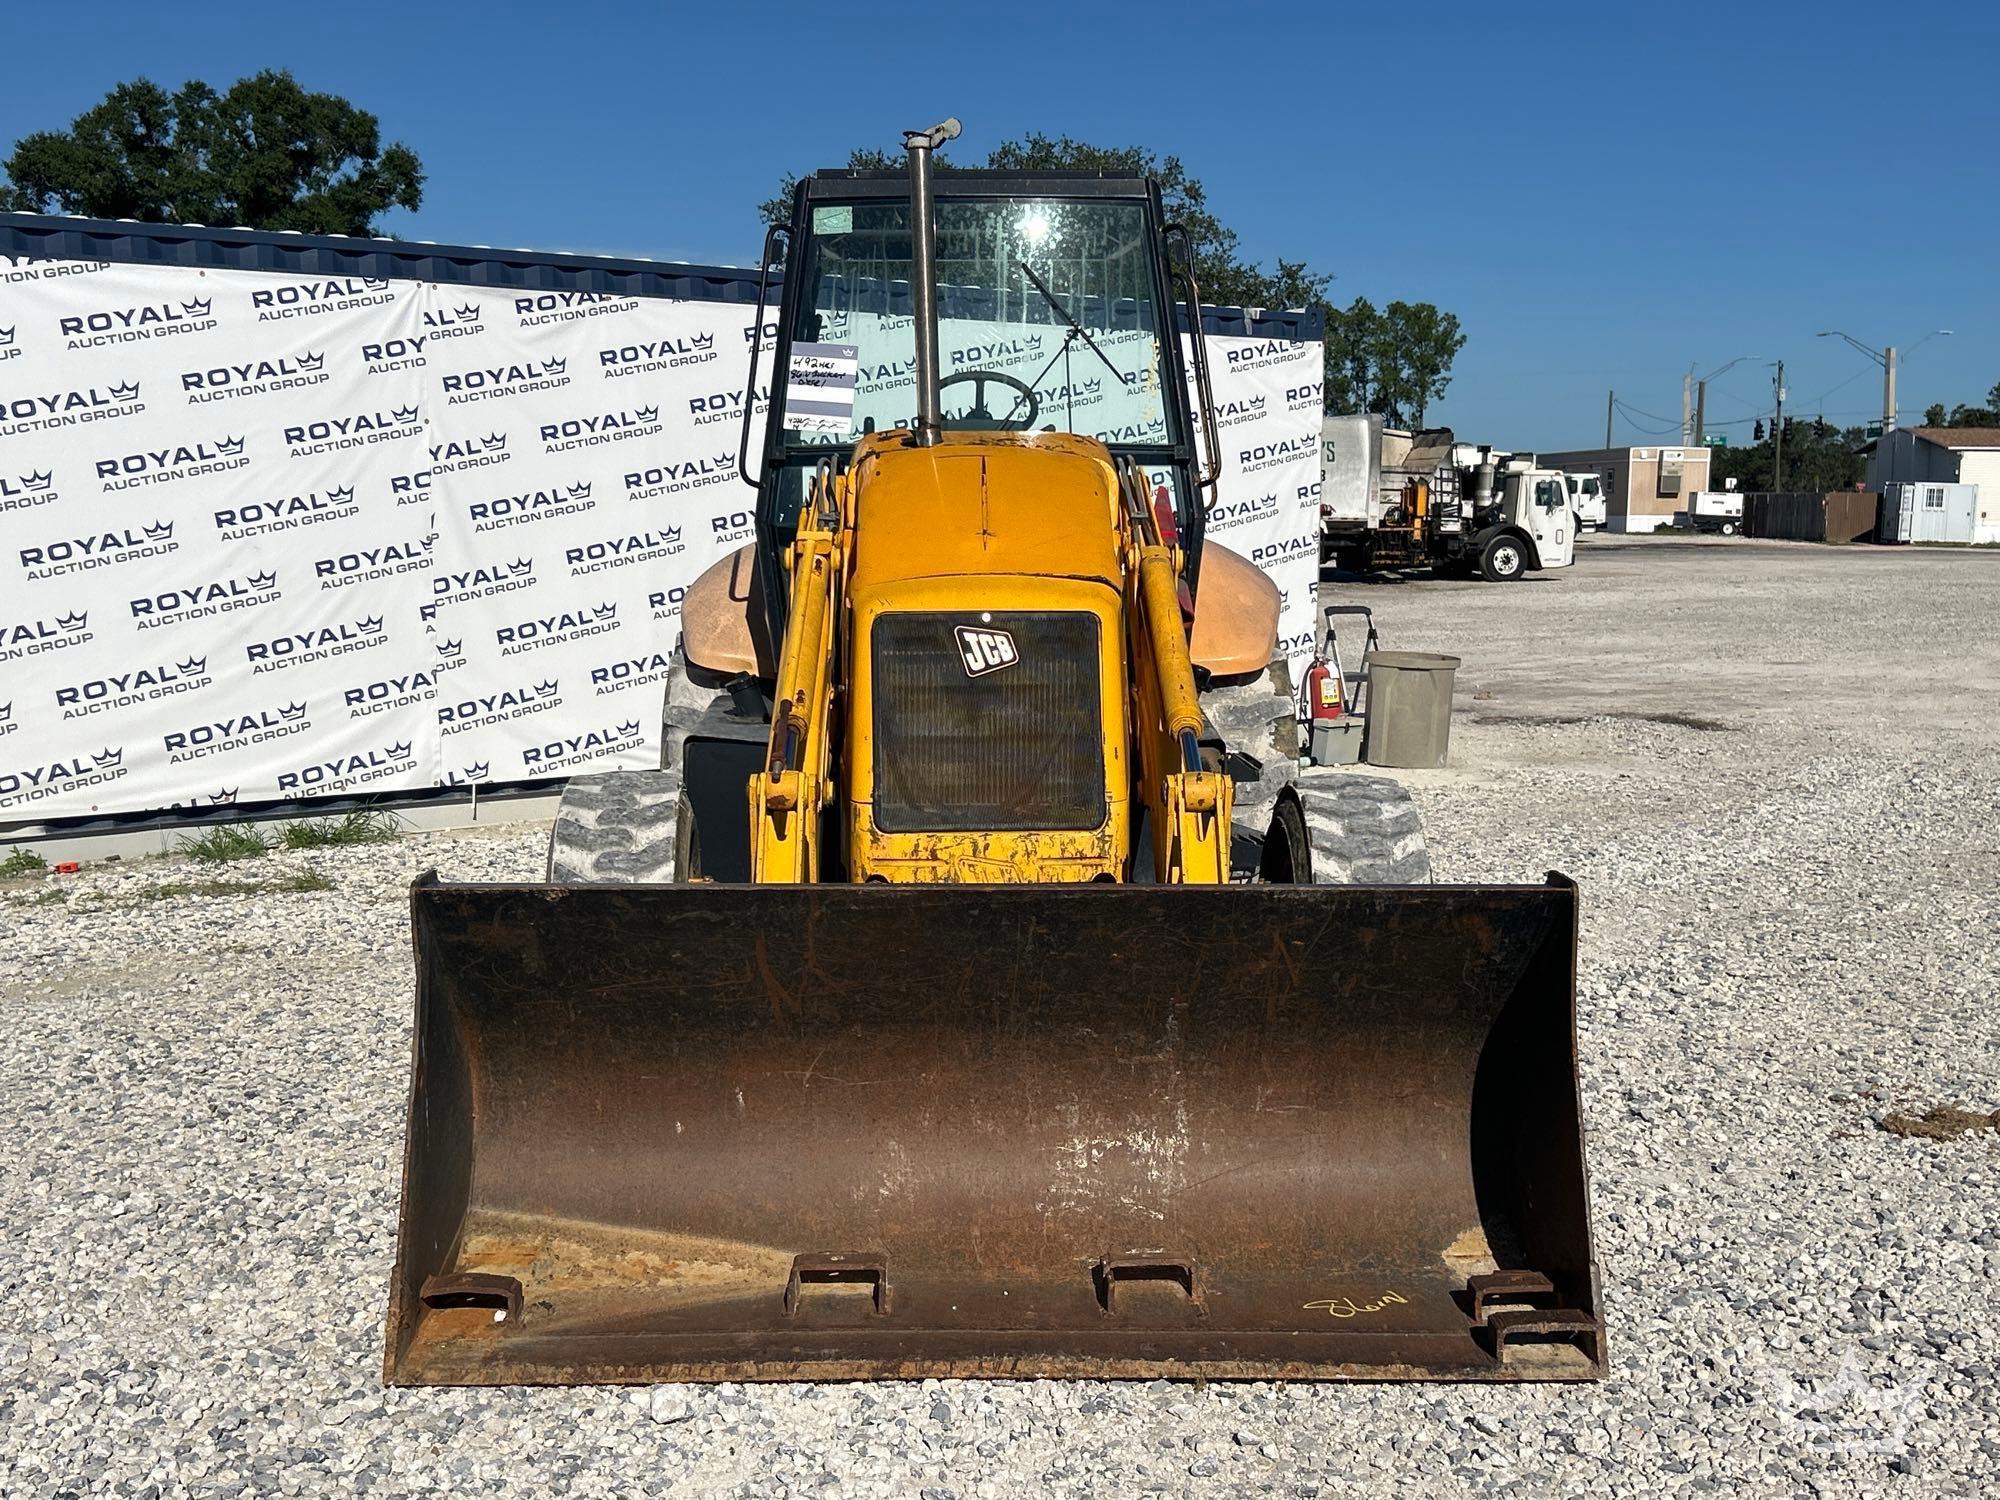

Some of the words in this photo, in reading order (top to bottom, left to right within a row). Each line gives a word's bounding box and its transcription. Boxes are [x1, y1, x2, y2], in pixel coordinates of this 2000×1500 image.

[43, 262, 110, 278] GROUP
[252, 279, 363, 309] ROYAL
[258, 303, 334, 322] AUCTION
[337, 293, 395, 311] GROUP
[60, 304, 183, 336] ROYAL
[519, 309, 585, 328] AUCTION
[588, 301, 639, 318] GROUP
[880, 320, 915, 331] AUCTI
[67, 329, 150, 350] AUCTION
[154, 320, 218, 338] GROUP
[430, 324, 484, 341] GROUP
[1117, 331, 1154, 346] GROUP
[362, 337, 426, 362] ROY
[599, 338, 692, 366] ROYAL
[951, 340, 1023, 365] ROYAL
[1227, 340, 1289, 363] ROYAL
[1230, 359, 1272, 374] AUCTION
[1273, 352, 1306, 365] GROUP
[181, 358, 298, 391] ROYAL
[367, 357, 426, 375] AUCTIO
[442, 363, 542, 392] ROYAL
[604, 359, 667, 379] AUCTION
[670, 352, 717, 369] GROUP
[188, 384, 266, 405] AUCTION
[269, 374, 329, 391] GROUP
[448, 386, 516, 406] AUCTION
[519, 376, 571, 394] GROUP
[855, 382, 884, 395] TION
[1286, 383, 1322, 402] ROY
[3, 415, 76, 435] UCTION
[80, 402, 145, 422] GROUP
[694, 409, 745, 425] AUCTIO
[1234, 411, 1267, 425] GROUP
[1288, 398, 1322, 412] AUCTIO
[284, 412, 393, 445] ROYAL
[290, 437, 364, 458] AUCTION
[367, 426, 421, 445] GROUP
[540, 412, 636, 441] ROYAL
[545, 435, 610, 454] AUCTION
[613, 425, 663, 442] GROUP
[96, 443, 216, 478] ROYAL
[429, 440, 482, 462] YAL
[458, 453, 511, 472] GROUP
[1240, 439, 1300, 464] ROYAL
[1242, 458, 1284, 474] AUCTION
[1286, 450, 1318, 463] GROUP
[102, 470, 184, 492] AUCTION
[188, 458, 250, 477] GROUP
[624, 457, 714, 489] ROYAL
[629, 482, 690, 501] AUCTION
[693, 471, 739, 490] GROUP
[214, 491, 328, 529] ROYAL
[470, 488, 567, 521] ROYAL
[475, 511, 541, 533] AUCTION
[544, 501, 596, 519] GROUP
[1246, 509, 1280, 523] GROUP
[220, 515, 298, 542] AUCTION
[301, 507, 360, 525] GROUP
[716, 529, 756, 544] AUCTI
[20, 530, 144, 568] ROYAL
[26, 556, 112, 582] AUCTION
[115, 542, 179, 563] GROUP
[314, 537, 422, 577] ROYAL
[566, 532, 660, 566] ROYAL
[571, 557, 637, 577] AUCTION
[640, 544, 685, 562] GROUP
[1252, 536, 1312, 562] ROYAL
[1256, 552, 1296, 570] UCTION
[320, 568, 393, 590] AUCTION
[434, 565, 510, 594] OYAL
[434, 590, 482, 608] CTION
[484, 577, 537, 597] GROUP
[130, 580, 248, 617] ROYAL
[136, 606, 217, 631] AUCTION
[220, 592, 281, 612] GROUP
[497, 610, 593, 644] ROYAL
[501, 633, 567, 657] AUCTION
[570, 621, 621, 640] GROUP
[27, 632, 94, 655] GROUP
[246, 624, 358, 662] ROYAL
[252, 650, 328, 675] AUCTION
[331, 635, 388, 655] GROUP
[963, 632, 1013, 671] JCB
[591, 650, 673, 684] ROYA
[56, 667, 178, 706] ROYAL
[62, 692, 145, 720] AUCTION
[148, 677, 213, 699] GROUP
[344, 671, 438, 706] ROYA
[595, 674, 658, 696] AUCTION
[349, 692, 422, 719] AUCTION
[438, 689, 534, 724] ROYAL
[441, 713, 509, 737] AUCTION
[512, 698, 563, 718] GROUP
[163, 713, 280, 752] ROYAL
[170, 737, 248, 765] AUCTION
[252, 721, 311, 744] GROUP
[523, 729, 618, 765] ROYAL
[277, 751, 386, 791] ROYAL
[528, 754, 594, 777] AUCTION
[596, 738, 645, 758] GROUP
[0, 759, 93, 794] OYAL
[0, 785, 59, 808] CTION
[63, 767, 128, 790] GROUP
[284, 777, 357, 801] AUCTION
[359, 760, 417, 783] GROUP
